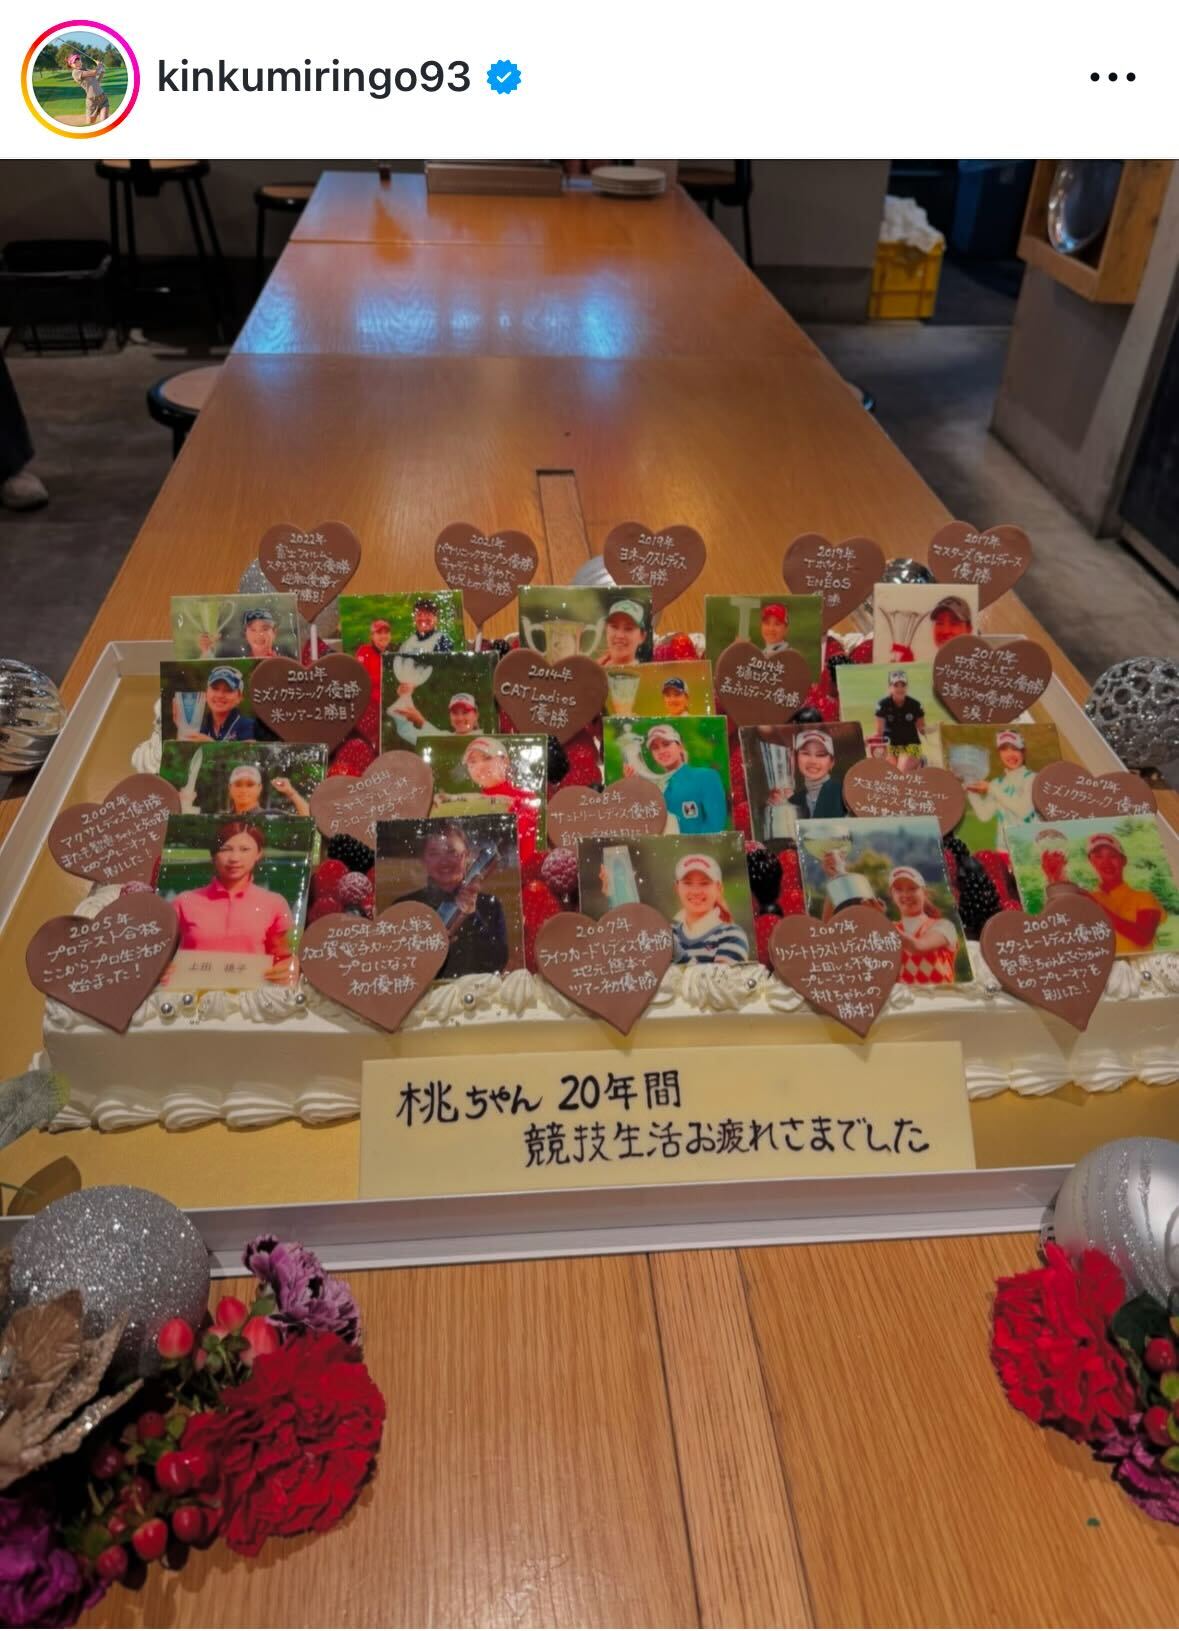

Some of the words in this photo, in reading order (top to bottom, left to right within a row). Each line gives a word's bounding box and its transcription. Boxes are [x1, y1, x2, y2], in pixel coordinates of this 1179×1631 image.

[289, 533, 327, 545] 2022年
[470, 534, 506, 550] 2021年
[638, 533, 675, 549] 2019年
[964, 533, 1001, 550] 2017年
[619, 547, 688, 570] ヨネックスレディス
[816, 545, 857, 560] 2019年
[629, 565, 669, 586] 優勝
[805, 575, 852, 590] ENEOS
[951, 562, 992, 584] 優勝
[748, 656, 785, 675] 2014年
[970, 647, 1018, 664] 2017年
[287, 666, 329, 682] 2011年
[528, 665, 574, 682] 2014年
[500, 681, 531, 699] CAT
[531, 687, 577, 706] Ladies
[529, 703, 569, 728] 優勝
[884, 771, 927, 785] 2007年
[1076, 776, 1121, 794] 2007年
[579, 789, 627, 806] 2008年
[80, 793, 130, 825] 2009年
[69, 913, 134, 938] 2005年
[576, 917, 632, 938] 2007年
[809, 919, 858, 938] 2007年
[1023, 912, 1071, 934] 2007年
[48, 921, 162, 962] プロテスト合格
[539, 929, 673, 967] ライフカードレディス優勝
[775, 930, 902, 961] リゾートトラストレディス優勝
[995, 920, 1112, 955] スタンレーレディス優勝
[43, 938, 172, 983] ここからプロ生活が
[339, 955, 417, 976] プロになって
[571, 955, 653, 978] 地元熊本で
[348, 974, 417, 996] 初優勝
[568, 970, 658, 996] ツアー初優勝
[800, 970, 874, 988] プレーオフは
[810, 986, 881, 1004] 桃ちゃんの
[837, 1001, 875, 1019] 勝利
[396, 1080, 543, 1127] 桃ちゃん
[557, 1069, 682, 1111] 20年間
[524, 1116, 931, 1168] 競技生活お疲れさまでした
